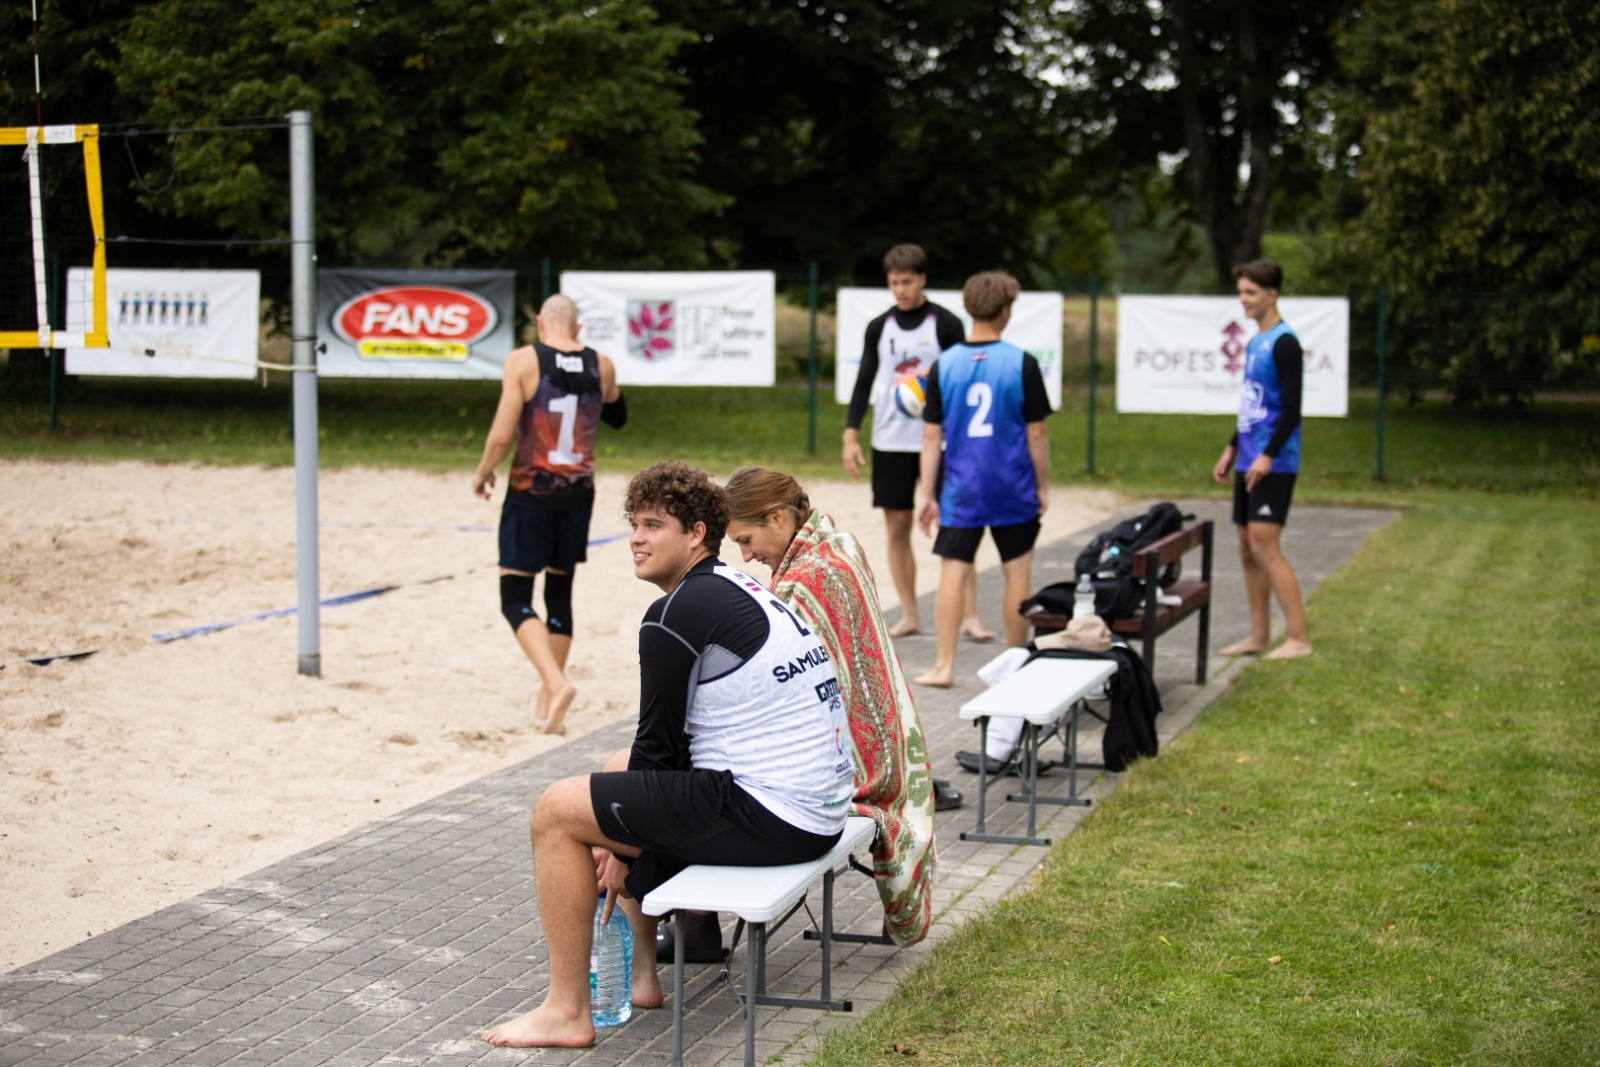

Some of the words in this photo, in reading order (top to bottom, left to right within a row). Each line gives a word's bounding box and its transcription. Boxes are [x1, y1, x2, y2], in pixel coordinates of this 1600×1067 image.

[361, 303, 470, 335] FANS
[1134, 351, 1217, 372] POPES
[547, 393, 584, 465] 1
[966, 382, 993, 438] 2
